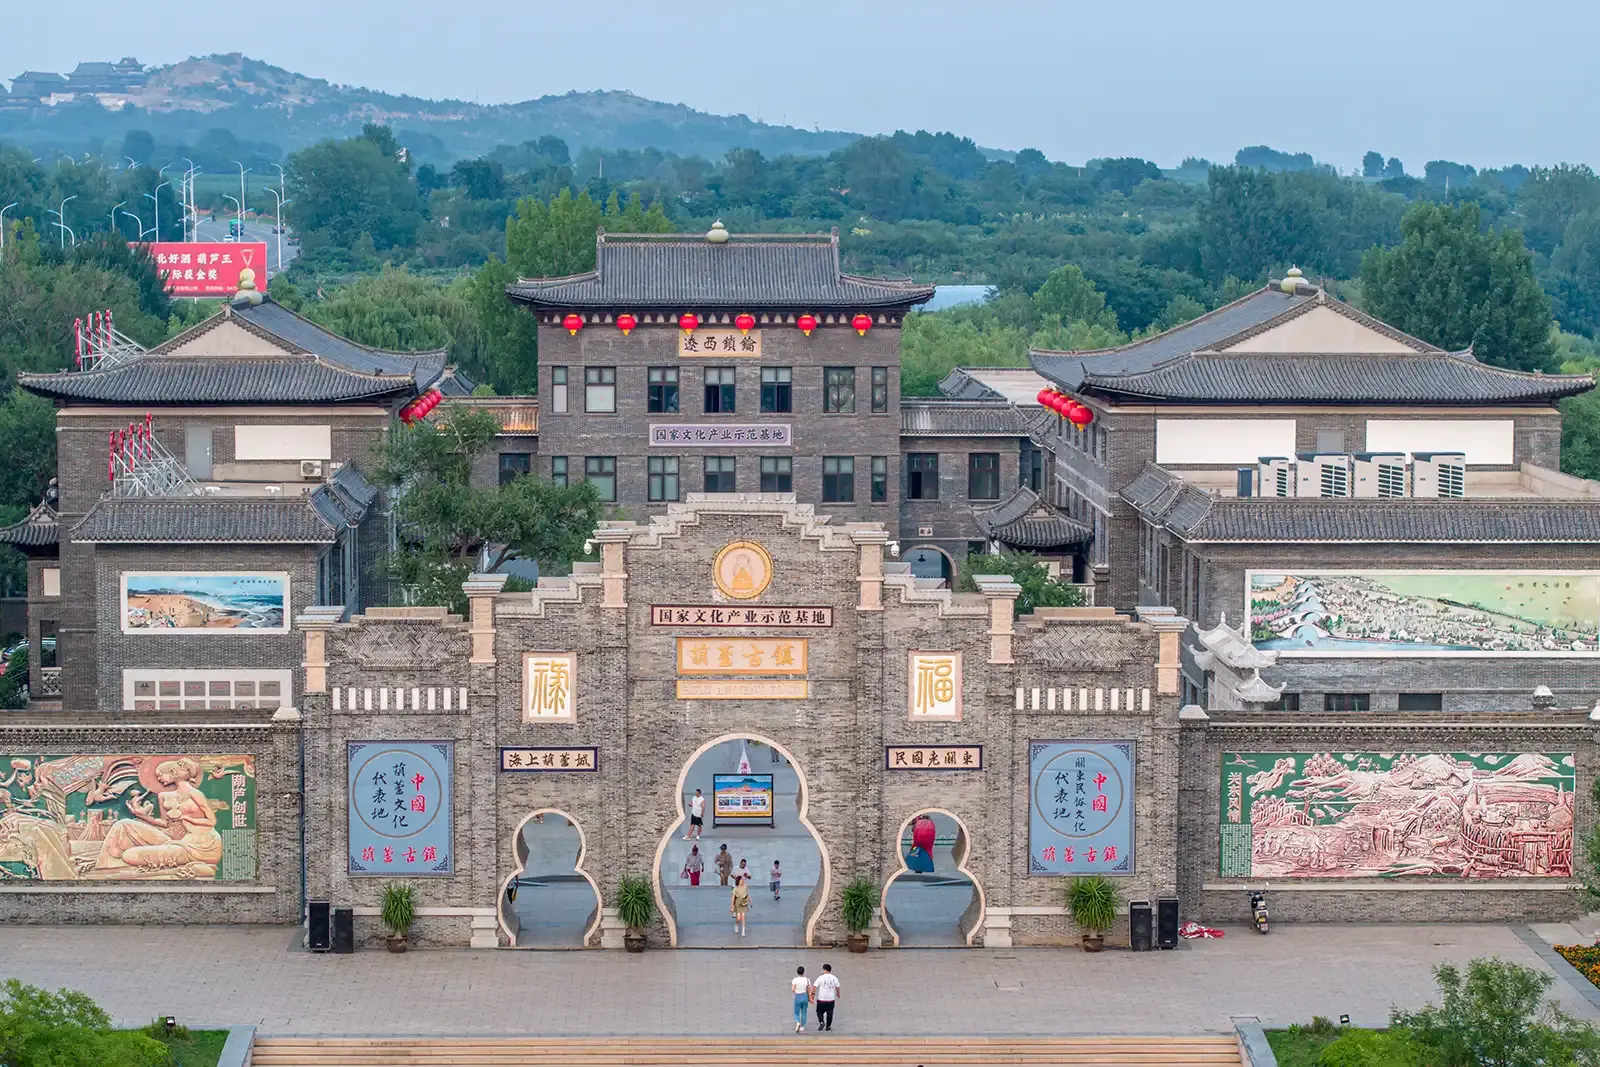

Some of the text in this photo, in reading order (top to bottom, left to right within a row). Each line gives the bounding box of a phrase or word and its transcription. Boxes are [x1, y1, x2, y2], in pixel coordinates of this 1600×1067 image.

[144, 253, 233, 265] 北好酒 葫芦王
[655, 428, 785, 441] 国家文化产业示范基地
[659, 609, 826, 624] 国家文化产业示范基地
[917, 658, 954, 714] 福
[371, 771, 389, 820] 代表地
[1052, 771, 1071, 820] 代表地
[1227, 772, 1242, 824] 关东风情
